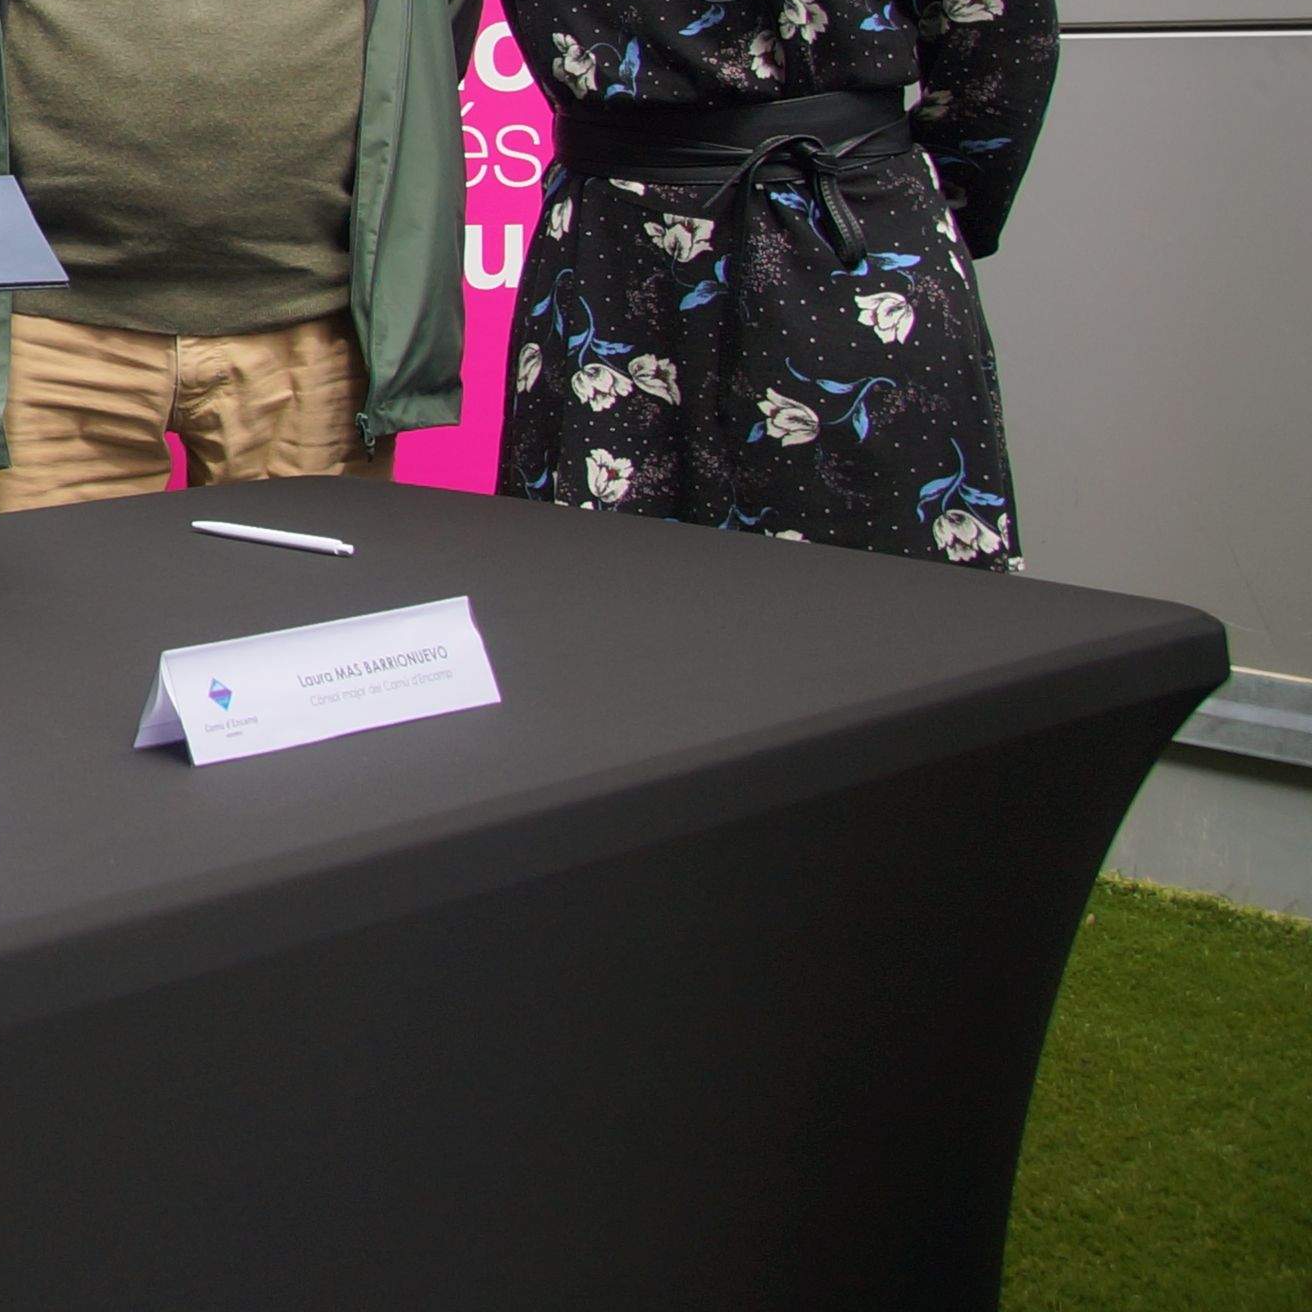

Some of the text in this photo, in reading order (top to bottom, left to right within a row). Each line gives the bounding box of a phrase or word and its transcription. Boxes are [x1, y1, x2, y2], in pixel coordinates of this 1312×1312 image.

[297, 645, 448, 688] Laura MAS BARRIONUEVO
